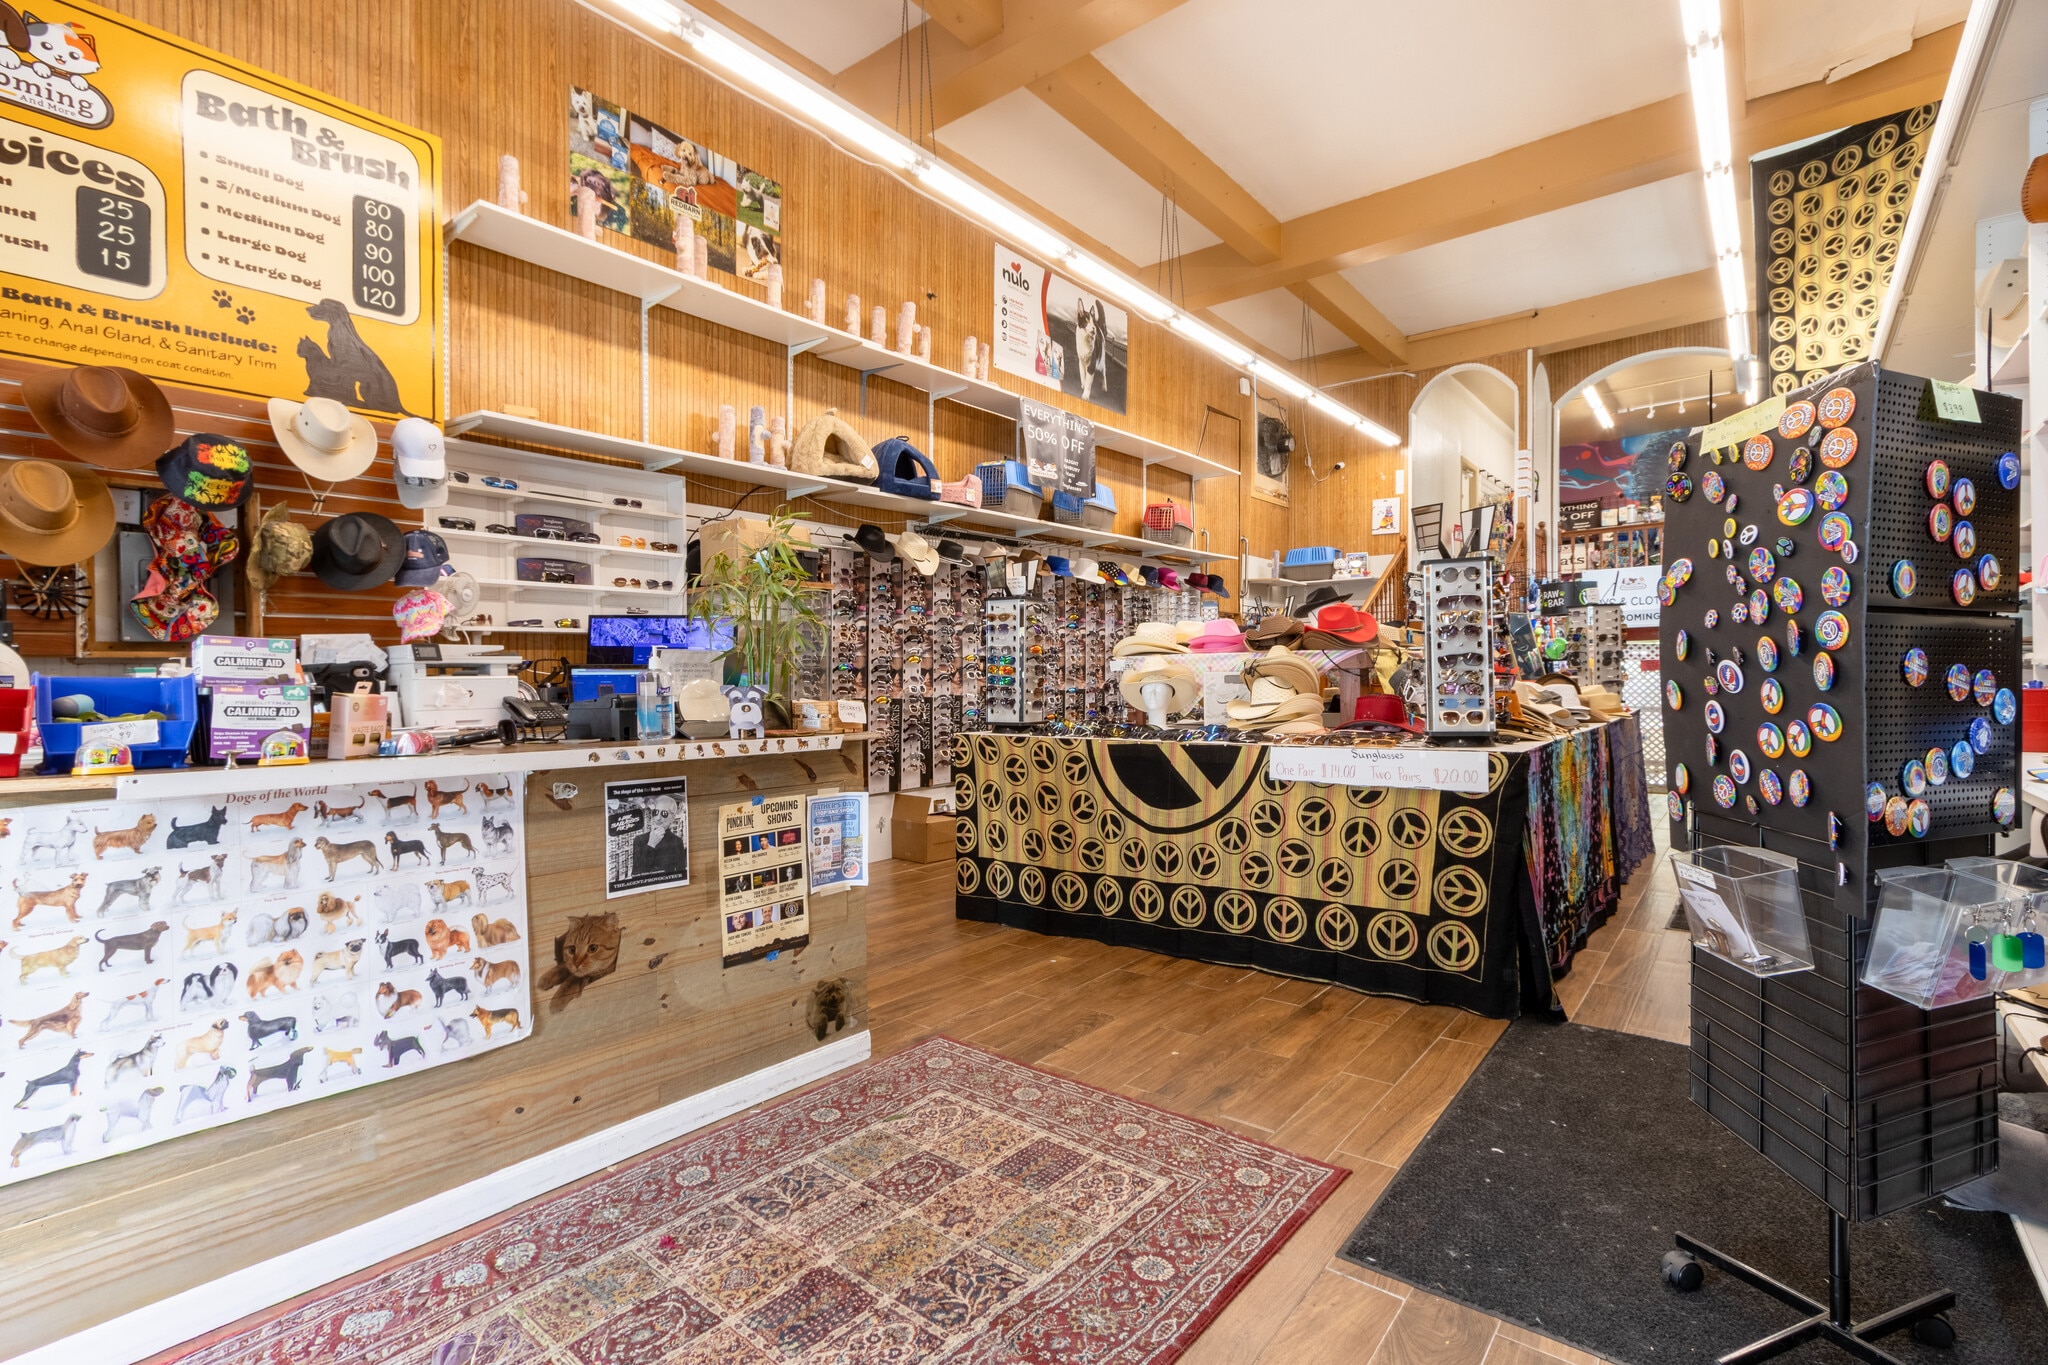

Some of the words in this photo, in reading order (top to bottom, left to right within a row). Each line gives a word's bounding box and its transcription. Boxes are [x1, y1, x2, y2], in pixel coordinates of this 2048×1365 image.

[19, 94, 44, 107] And
[47, 103, 77, 117] More
[195, 90, 308, 138] Bath
[315, 127, 345, 151] &
[215, 154, 270, 178] Small
[273, 173, 305, 191] Dog
[290, 137, 410, 191] Brush
[0, 205, 37, 221] nd
[98, 198, 134, 220] 25
[216, 180, 309, 215] S/Medium
[311, 208, 342, 226] Dog
[364, 200, 392, 220] 60
[670, 198, 701, 215] REDBARN
[97, 221, 136, 246] 25
[216, 205, 291, 233] Medium
[294, 227, 325, 244] Dog
[365, 220, 393, 241] 80
[216, 230, 272, 252] Large
[275, 246, 307, 263] Dog
[364, 243, 393, 264] 90
[101, 248, 131, 270] 15
[218, 255, 230, 266] X
[234, 260, 288, 280] Large
[291, 274, 322, 290] Dog
[362, 264, 395, 287] 100
[1002, 267, 1031, 292] nulo
[362, 286, 396, 309] 120
[2, 287, 73, 312] Bath
[77, 304, 98, 317] &
[102, 308, 181, 333] Brush
[184, 325, 278, 354] Include:
[58, 318, 99, 335] Anal
[103, 326, 155, 348] Gland,
[159, 336, 172, 350] &
[175, 340, 243, 366] Sanitary
[248, 355, 278, 370] Trim
[15, 333, 31, 341] to
[33, 336, 78, 352] change
[79, 345, 138, 364] depending
[140, 357, 154, 366] on
[156, 359, 181, 370] coat
[183, 365, 234, 380] condition.
[1024, 404, 1089, 436] EVERYTHING
[1027, 424, 1058, 446] 50%
[1061, 435, 1085, 454] OFF
[1570, 510, 1595, 520] OFF
[1543, 589, 1560, 599] RAW
[1547, 597, 1565, 608] BAR
[216, 657, 263, 667] CALMING
[266, 659, 283, 668] AID
[226, 707, 277, 717] CALMING
[278, 707, 298, 718] AID
[371, 725, 384, 733] BAGS
[1351, 749, 1405, 763] Sunglasses
[1275, 762, 1295, 777] One
[1298, 763, 1315, 777] Pair
[1368, 765, 1392, 782] Two
[1397, 766, 1422, 784] Pairs
[1433, 767, 1479, 785] $20.00
[225, 792, 257, 805] Dogs
[259, 789, 271, 803] of
[271, 787, 292, 800] the
[293, 785, 328, 797] World
[761, 800, 799, 815] UPCOMING
[767, 812, 792, 825] SHOWS
